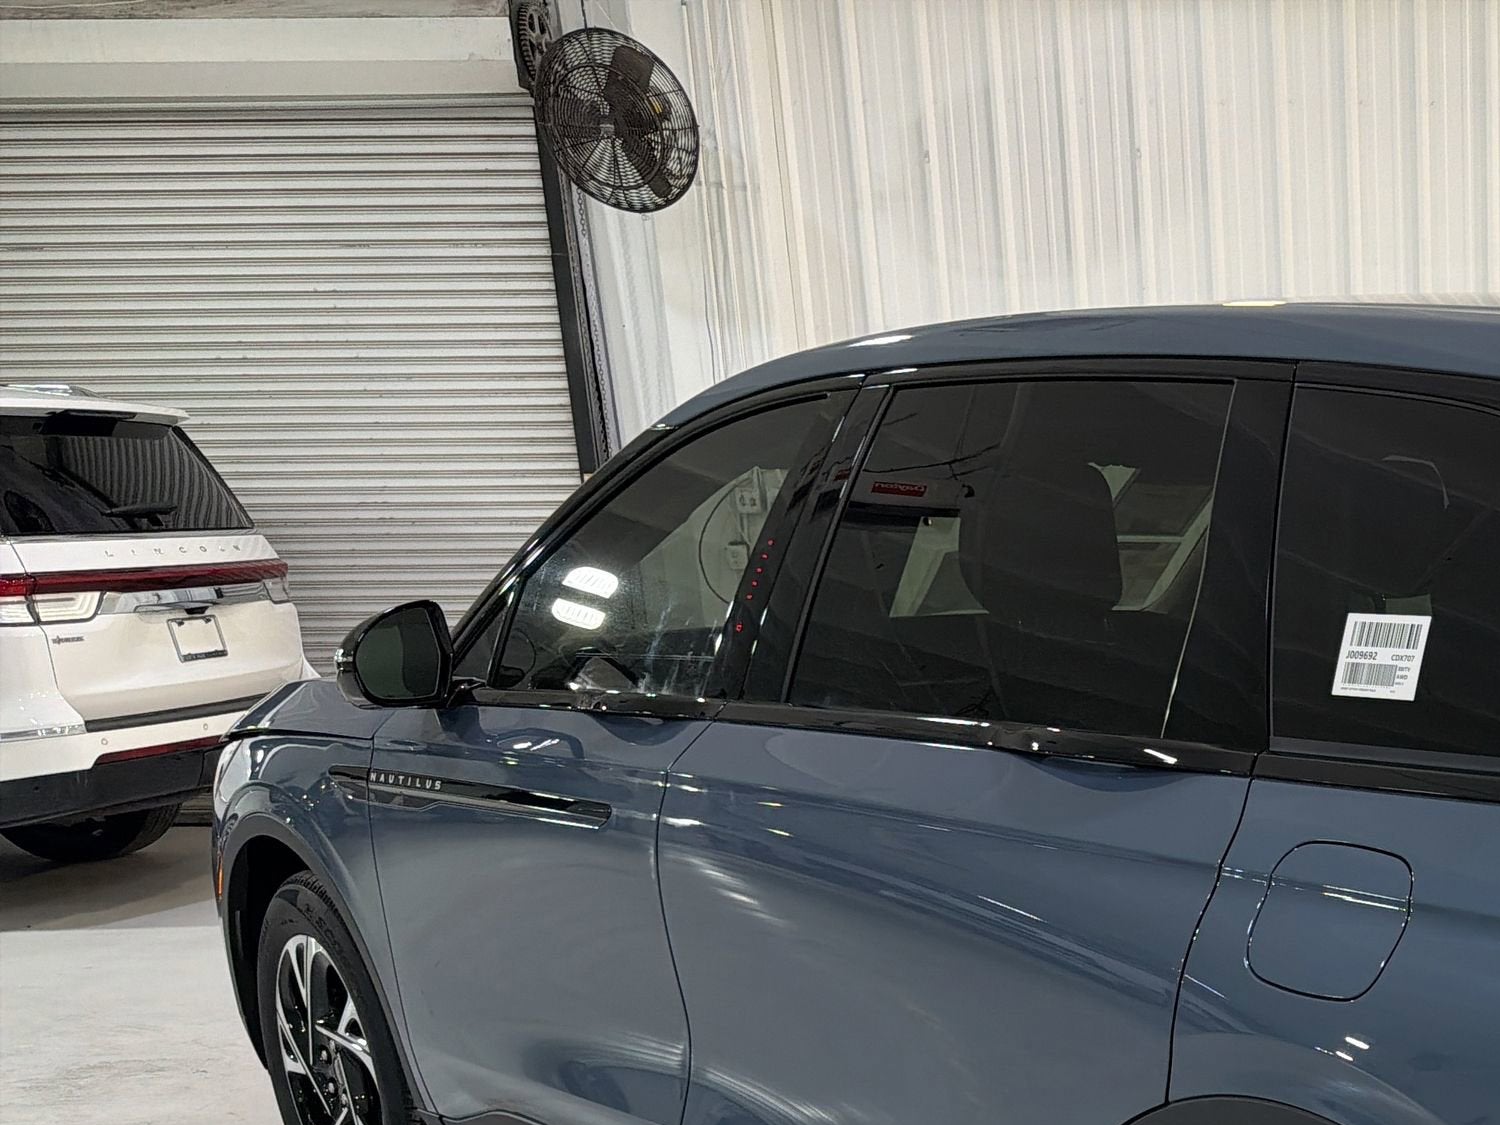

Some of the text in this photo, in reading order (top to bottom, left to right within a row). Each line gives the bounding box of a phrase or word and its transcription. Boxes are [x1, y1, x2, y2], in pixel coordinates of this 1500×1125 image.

[105, 544, 242, 558] LINCOLN
[1345, 650, 1416, 663] J009692 CDX707
[370, 772, 442, 790] NAUTILUS
